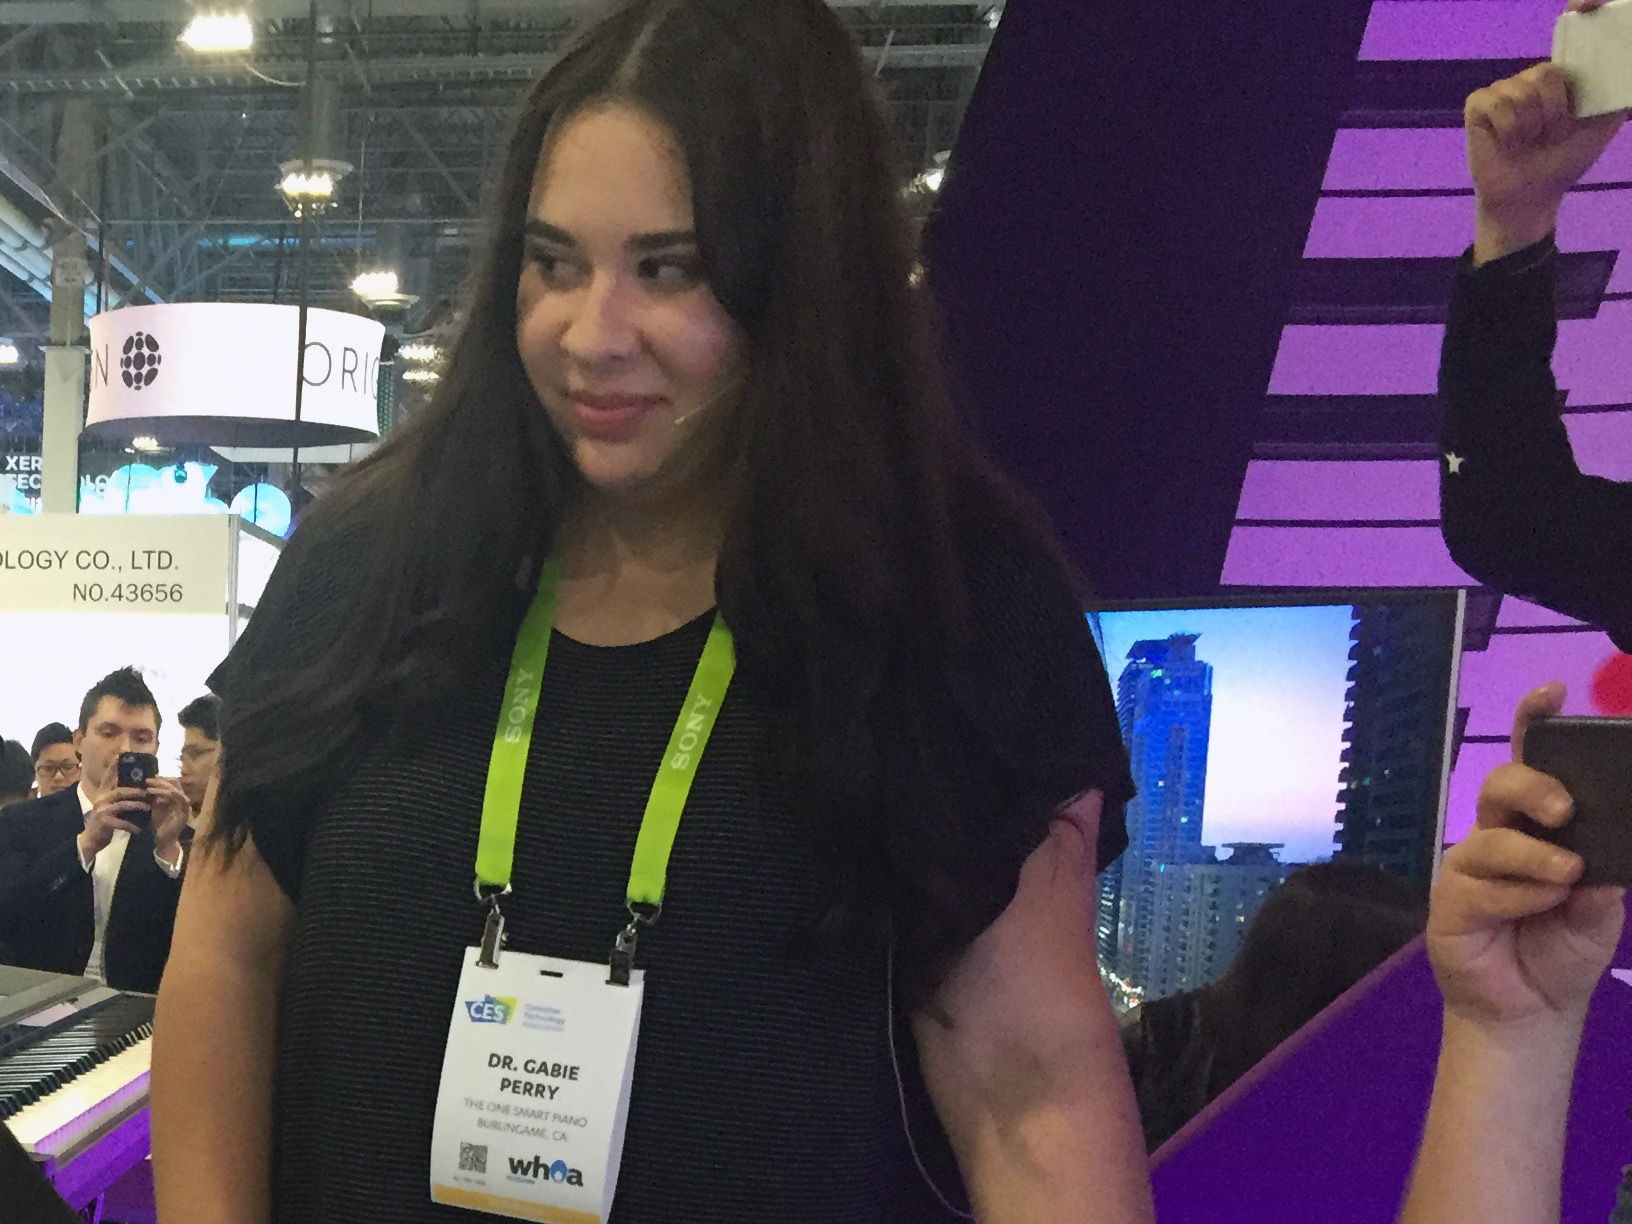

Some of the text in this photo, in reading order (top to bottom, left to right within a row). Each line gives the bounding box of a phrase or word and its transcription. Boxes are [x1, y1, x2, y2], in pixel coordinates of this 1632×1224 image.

[5, 455, 42, 471] XER
[75, 550, 123, 573] CO.,
[131, 550, 180, 570] LTD.
[73, 583, 184, 603] NO.43656
[504, 667, 535, 743] SONY
[670, 692, 712, 770] SONY
[469, 1001, 505, 1022] CES
[488, 1053, 580, 1081] DR. GABIE
[499, 1077, 560, 1100] PERRY
[464, 1098, 588, 1128] THE ONE SMART PIANO
[552, 1130, 568, 1142] CA
[508, 1155, 584, 1187] whoa
